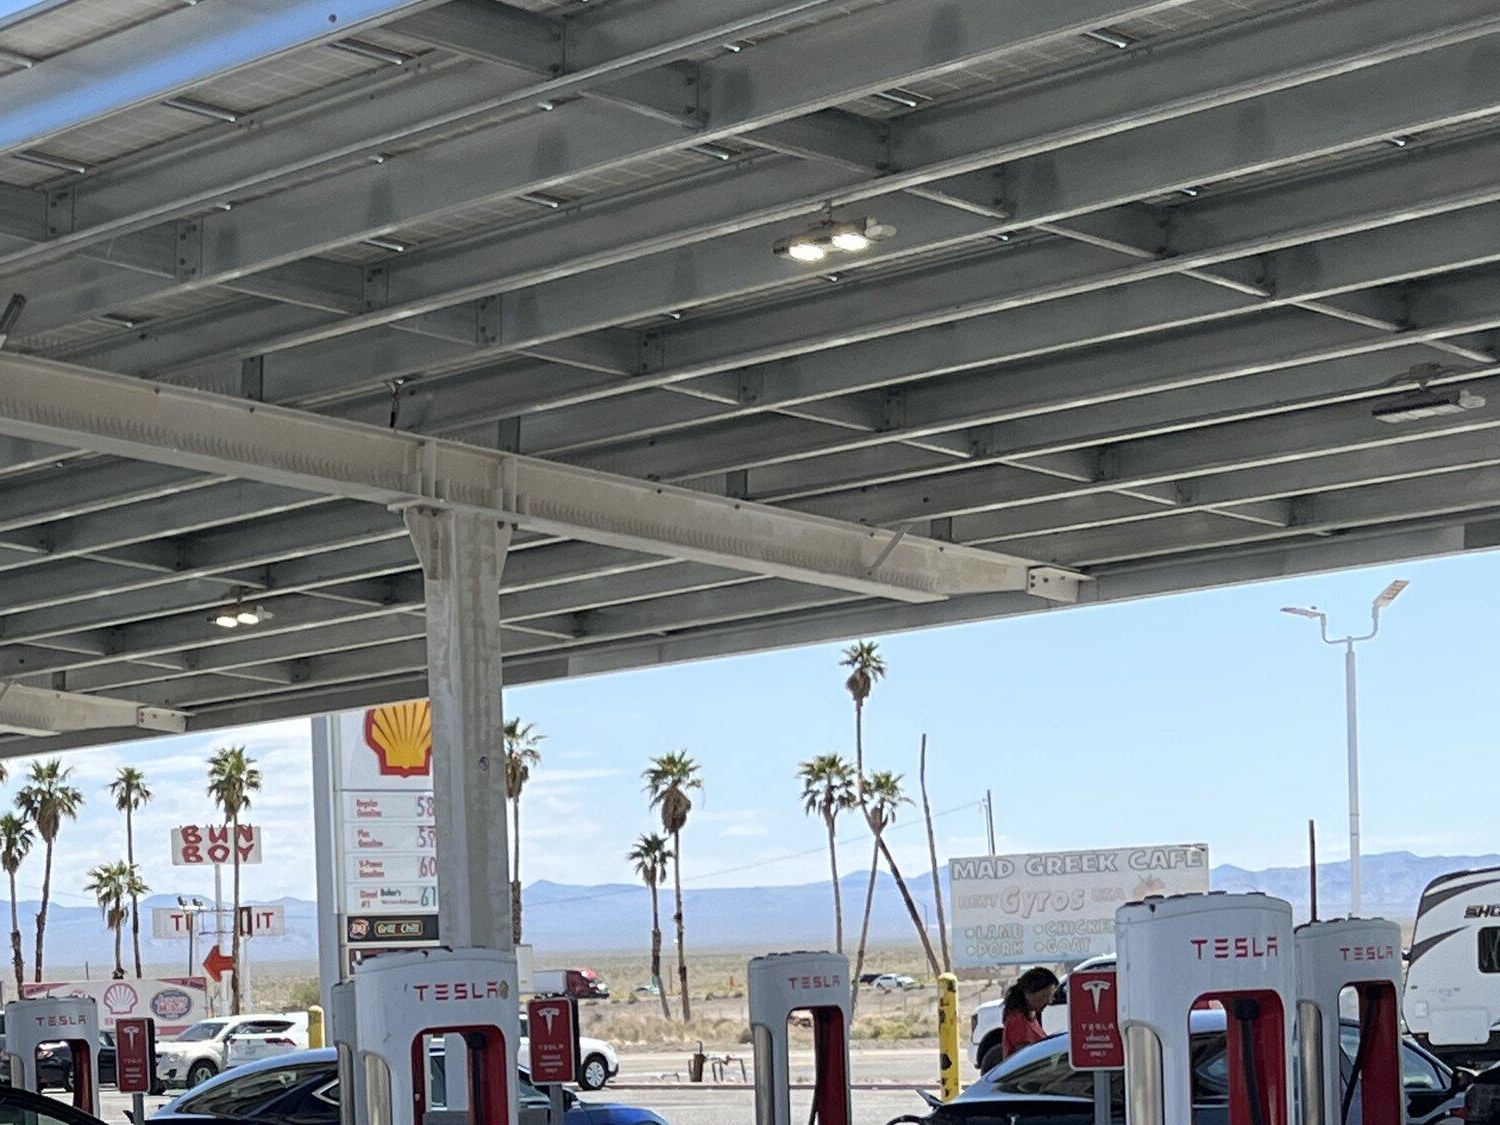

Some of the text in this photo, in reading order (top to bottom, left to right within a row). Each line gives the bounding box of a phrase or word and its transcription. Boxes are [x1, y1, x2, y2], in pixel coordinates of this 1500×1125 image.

[181, 823, 253, 844] BUN
[182, 844, 254, 863] BOY
[951, 857, 1015, 881] MAD
[1025, 852, 1119, 876] GREEK
[1001, 885, 1086, 920] Gyros
[976, 923, 1025, 941] LAMB
[976, 936, 1092, 957] PORK GOAT
[1190, 937, 1279, 960] TESLA
[1339, 945, 1394, 962] TESLA
[413, 980, 500, 1002] TESLA
[788, 974, 841, 990] TESLA
[35, 1014, 87, 1027] TESLA
